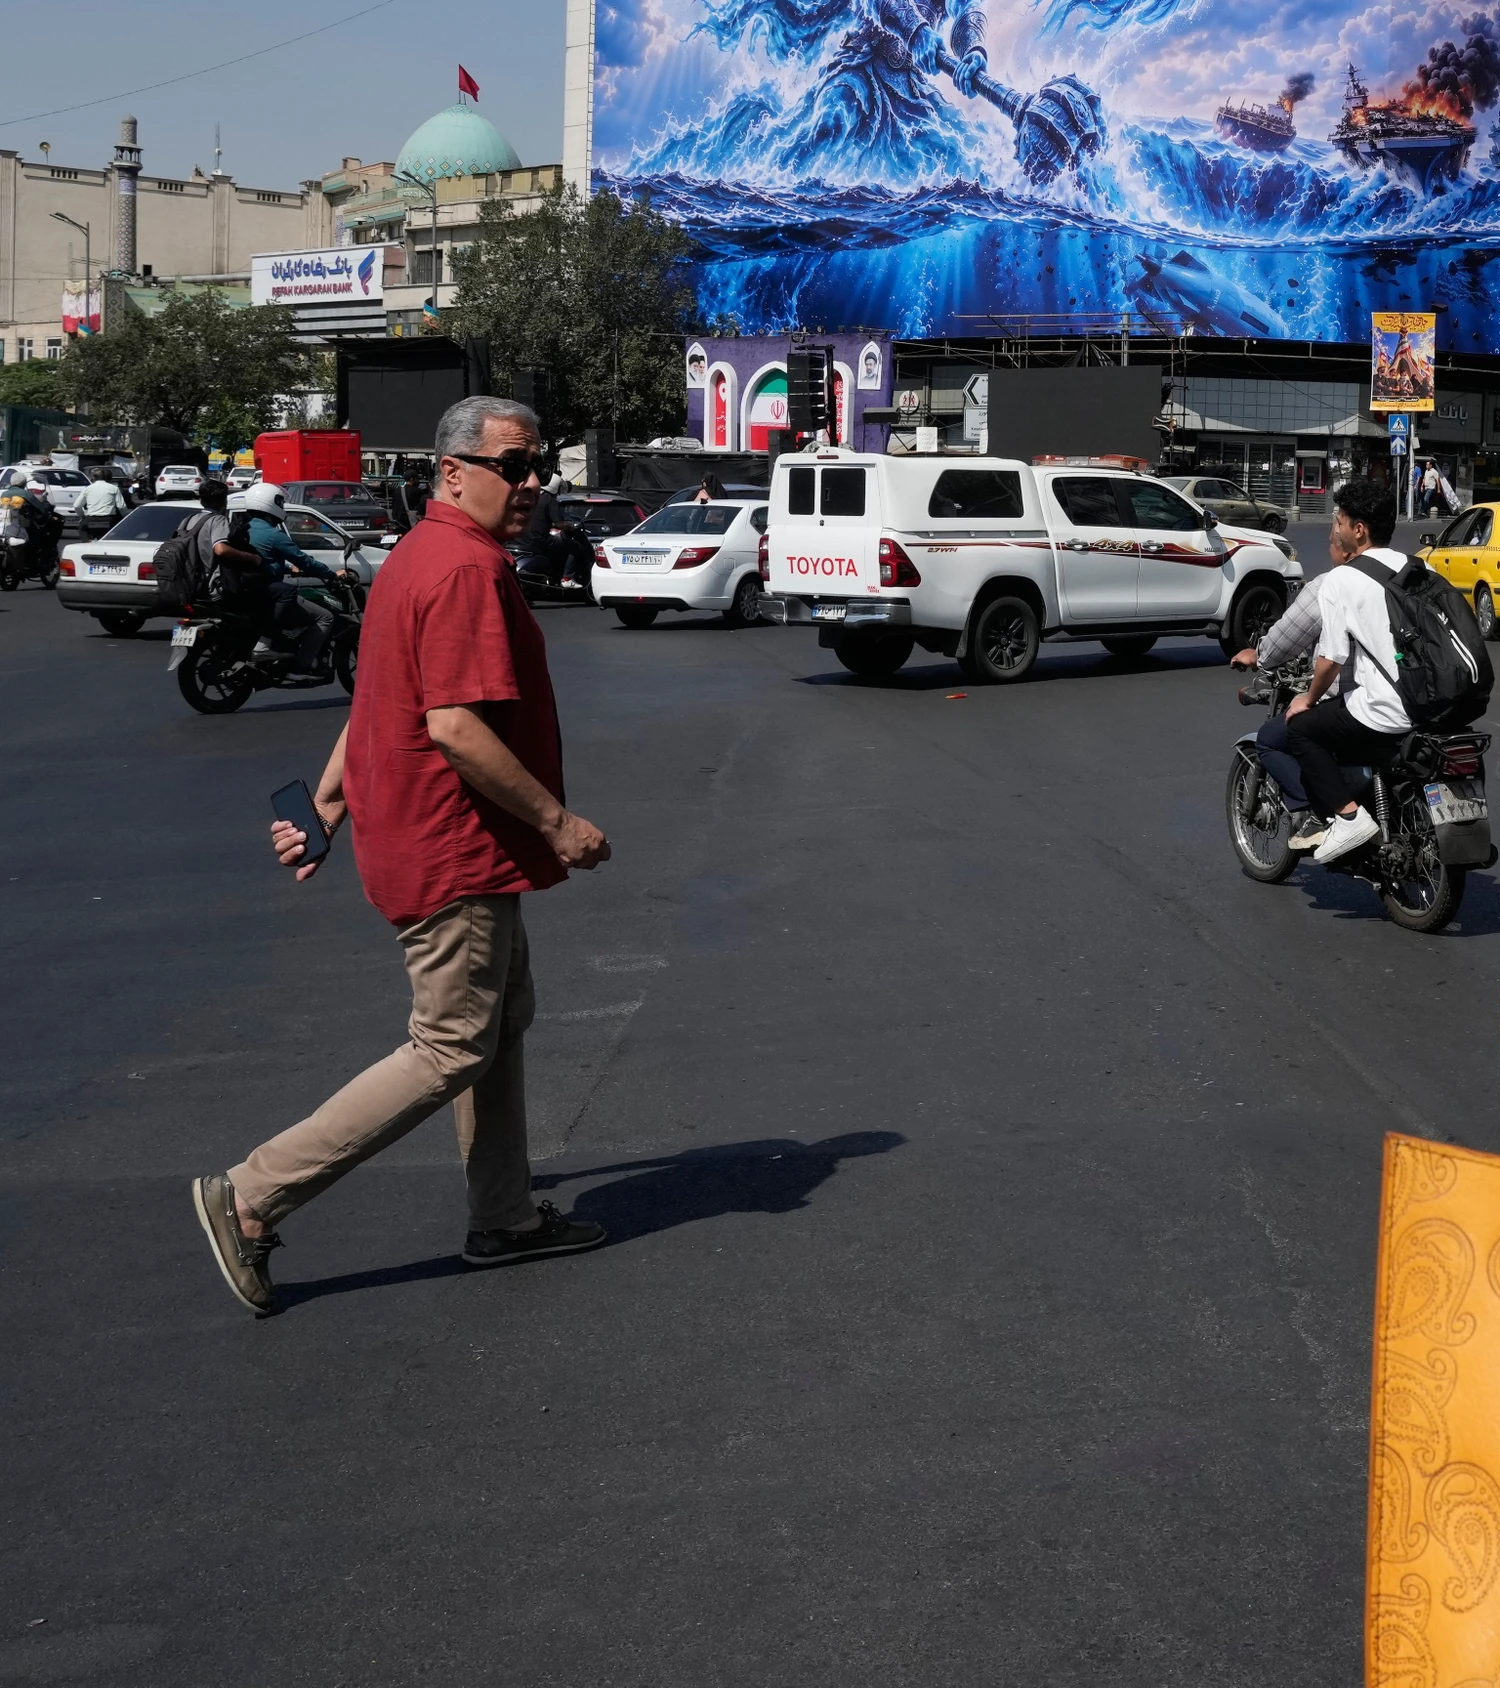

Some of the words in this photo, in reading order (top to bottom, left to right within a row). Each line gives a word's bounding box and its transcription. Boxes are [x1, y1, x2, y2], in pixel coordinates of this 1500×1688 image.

[271, 259, 303, 282] کارگران
[303, 256, 327, 279] رفاه
[327, 255, 353, 279] بانک
[272, 284, 293, 297] REFAH
[294, 282, 332, 296] KARGARAN
[333, 281, 353, 294] BANK
[1437, 405, 1469, 425] بانک
[786, 556, 859, 577] TOYOTA
